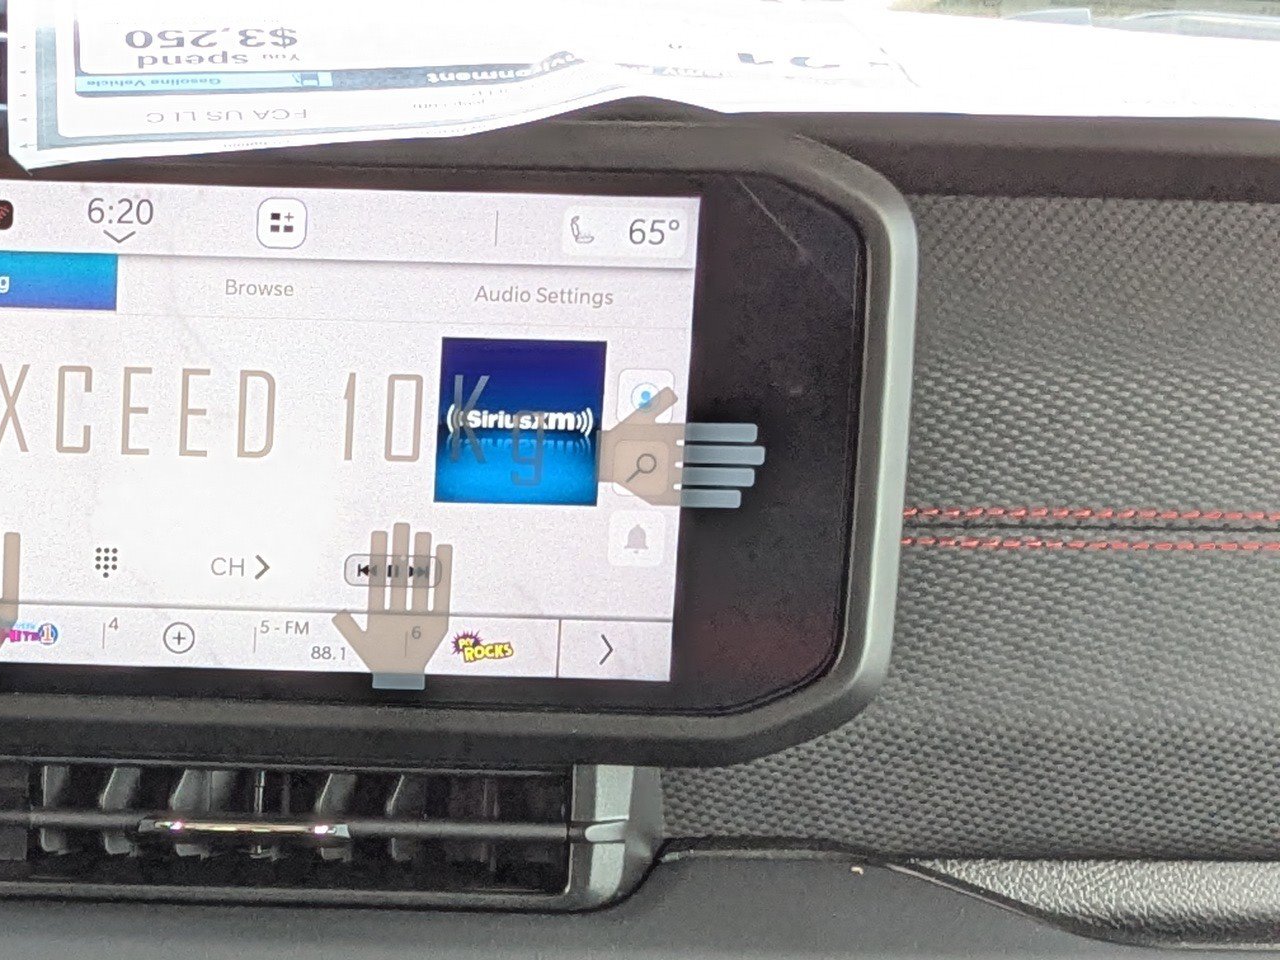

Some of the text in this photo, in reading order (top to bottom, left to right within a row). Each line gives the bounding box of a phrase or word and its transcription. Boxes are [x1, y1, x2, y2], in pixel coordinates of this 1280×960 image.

[125, 27, 297, 50] $3,250
[138, 51, 248, 70] spend
[87, 78, 222, 88] Gasoline Vehicle
[206, 110, 244, 123] US
[253, 109, 307, 122] FCA
[86, 197, 155, 226] 6:20
[627, 217, 681, 246] 65°
[224, 277, 295, 299] Browse
[474, 284, 615, 310] Audio Settings
[210, 556, 246, 578] CH
[109, 617, 120, 630] 4
[260, 620, 270, 634] 5
[285, 621, 310, 636] FM
[411, 626, 422, 639] 6
[310, 646, 347, 661] 88.1
[465, 642, 513, 662] ROCKS
